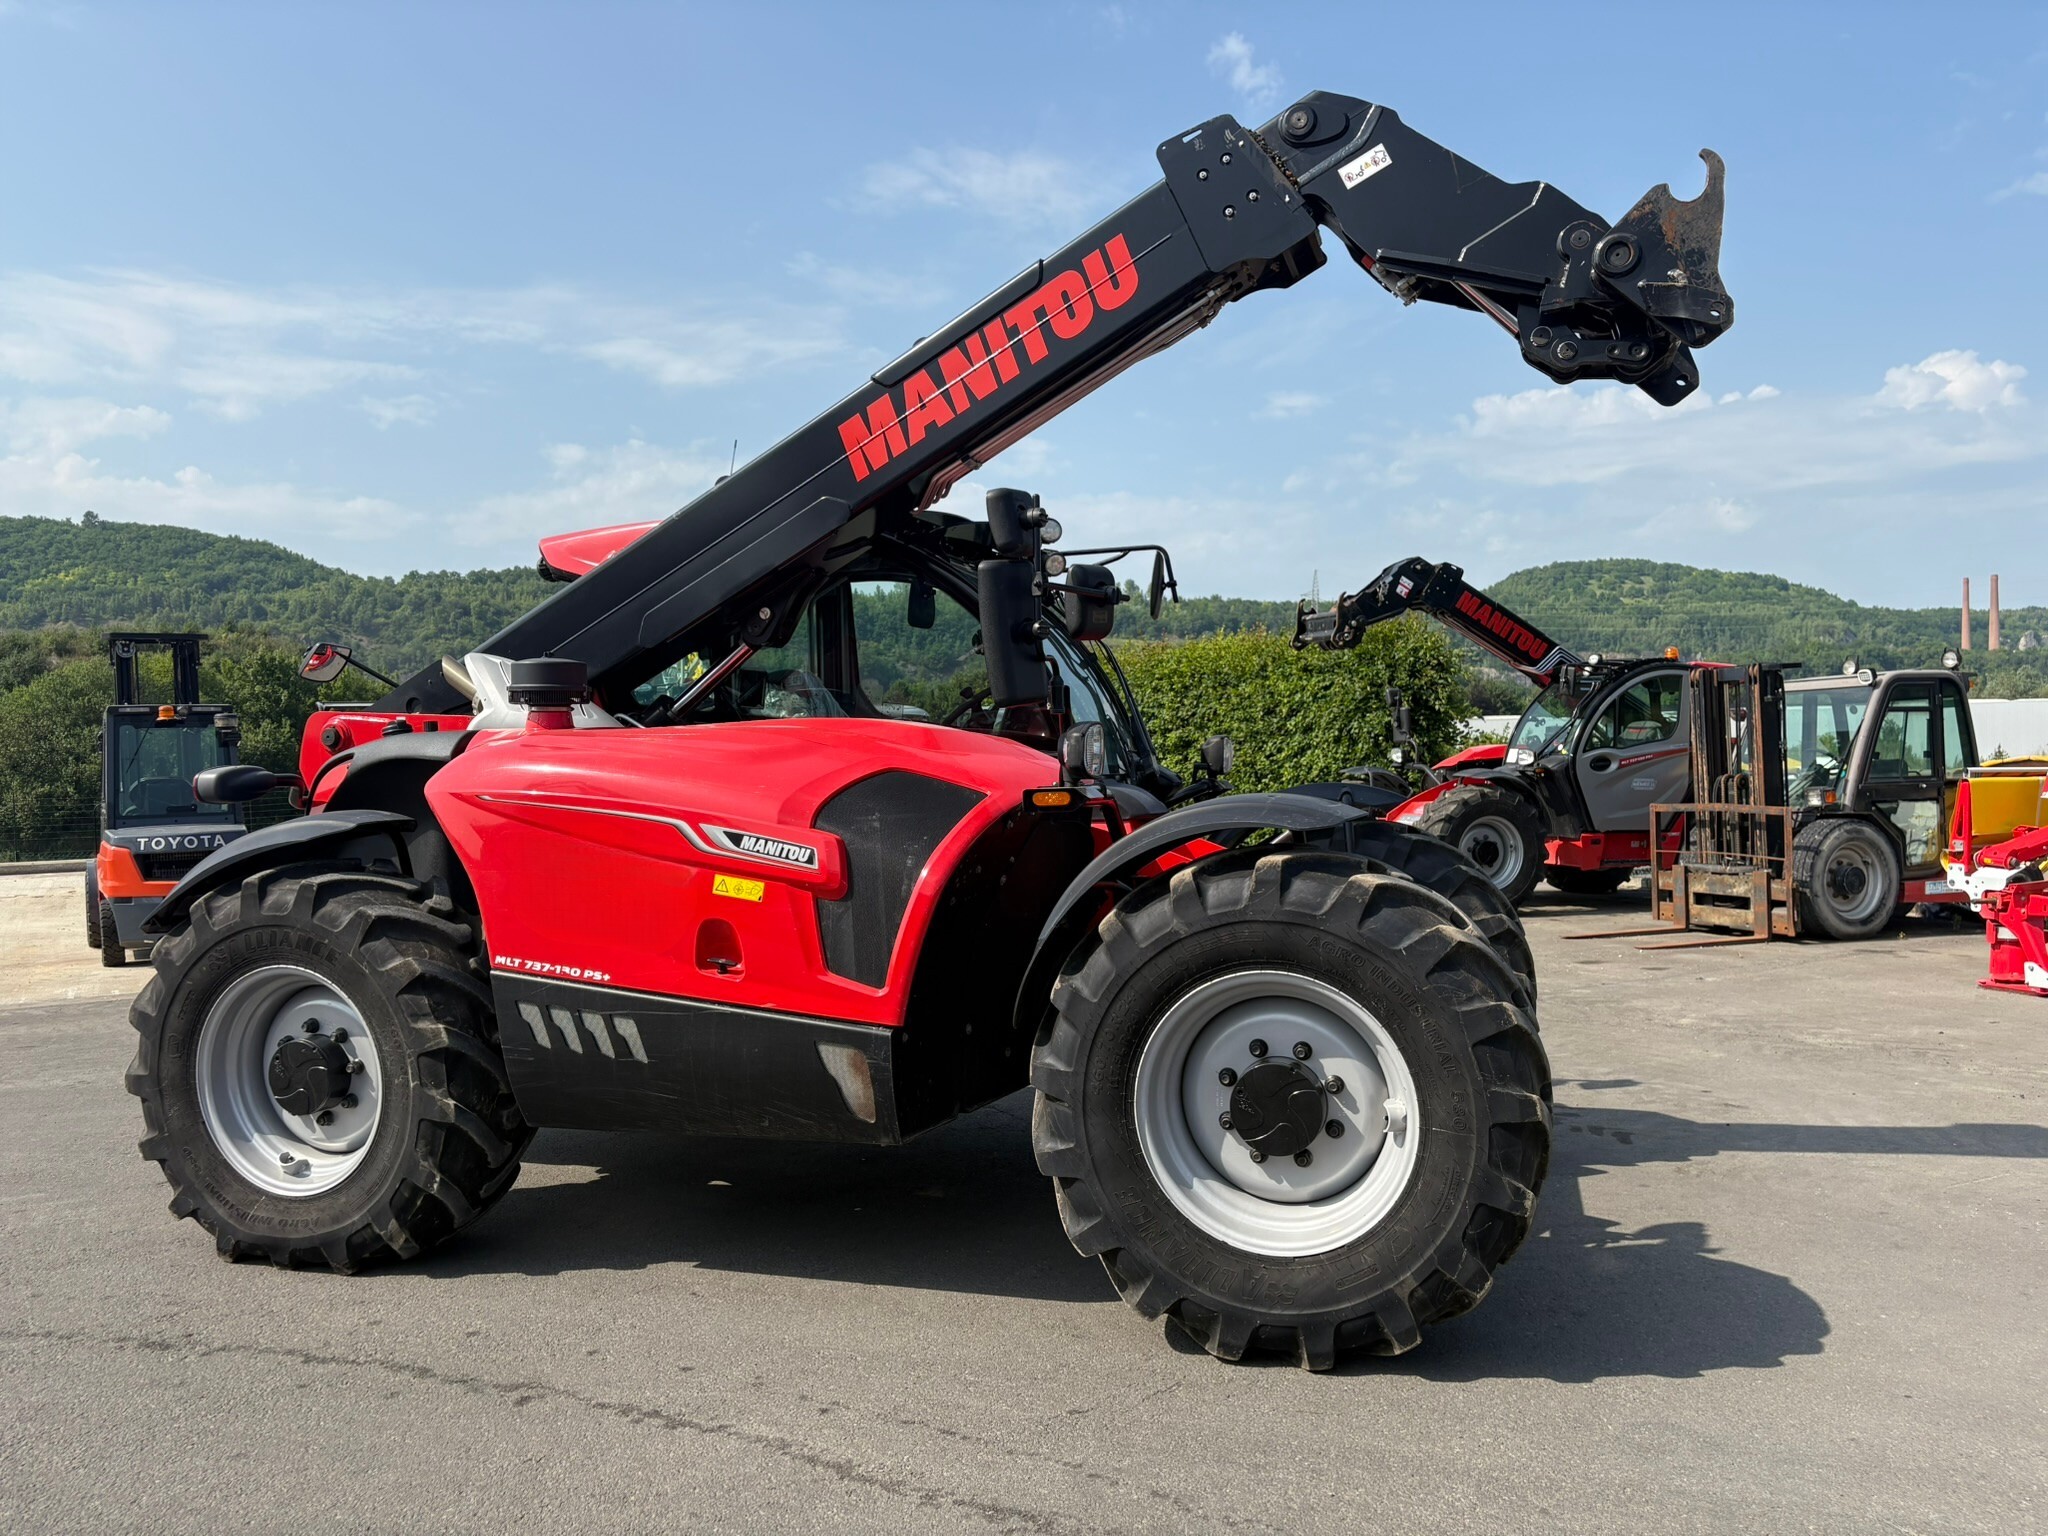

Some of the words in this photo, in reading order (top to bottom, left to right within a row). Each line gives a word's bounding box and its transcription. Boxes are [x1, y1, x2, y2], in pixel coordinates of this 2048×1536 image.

[837, 233, 1139, 483] MANITOU
[1455, 590, 1549, 660] MANITOU
[137, 834, 227, 851] TOYOTA
[740, 835, 812, 863] MANITOU
[494, 955, 522, 968] MLT
[583, 969, 611, 982] PS+
[1307, 935, 1366, 968] AGRO
[1369, 964, 1457, 1079] INDUSTRIAL
